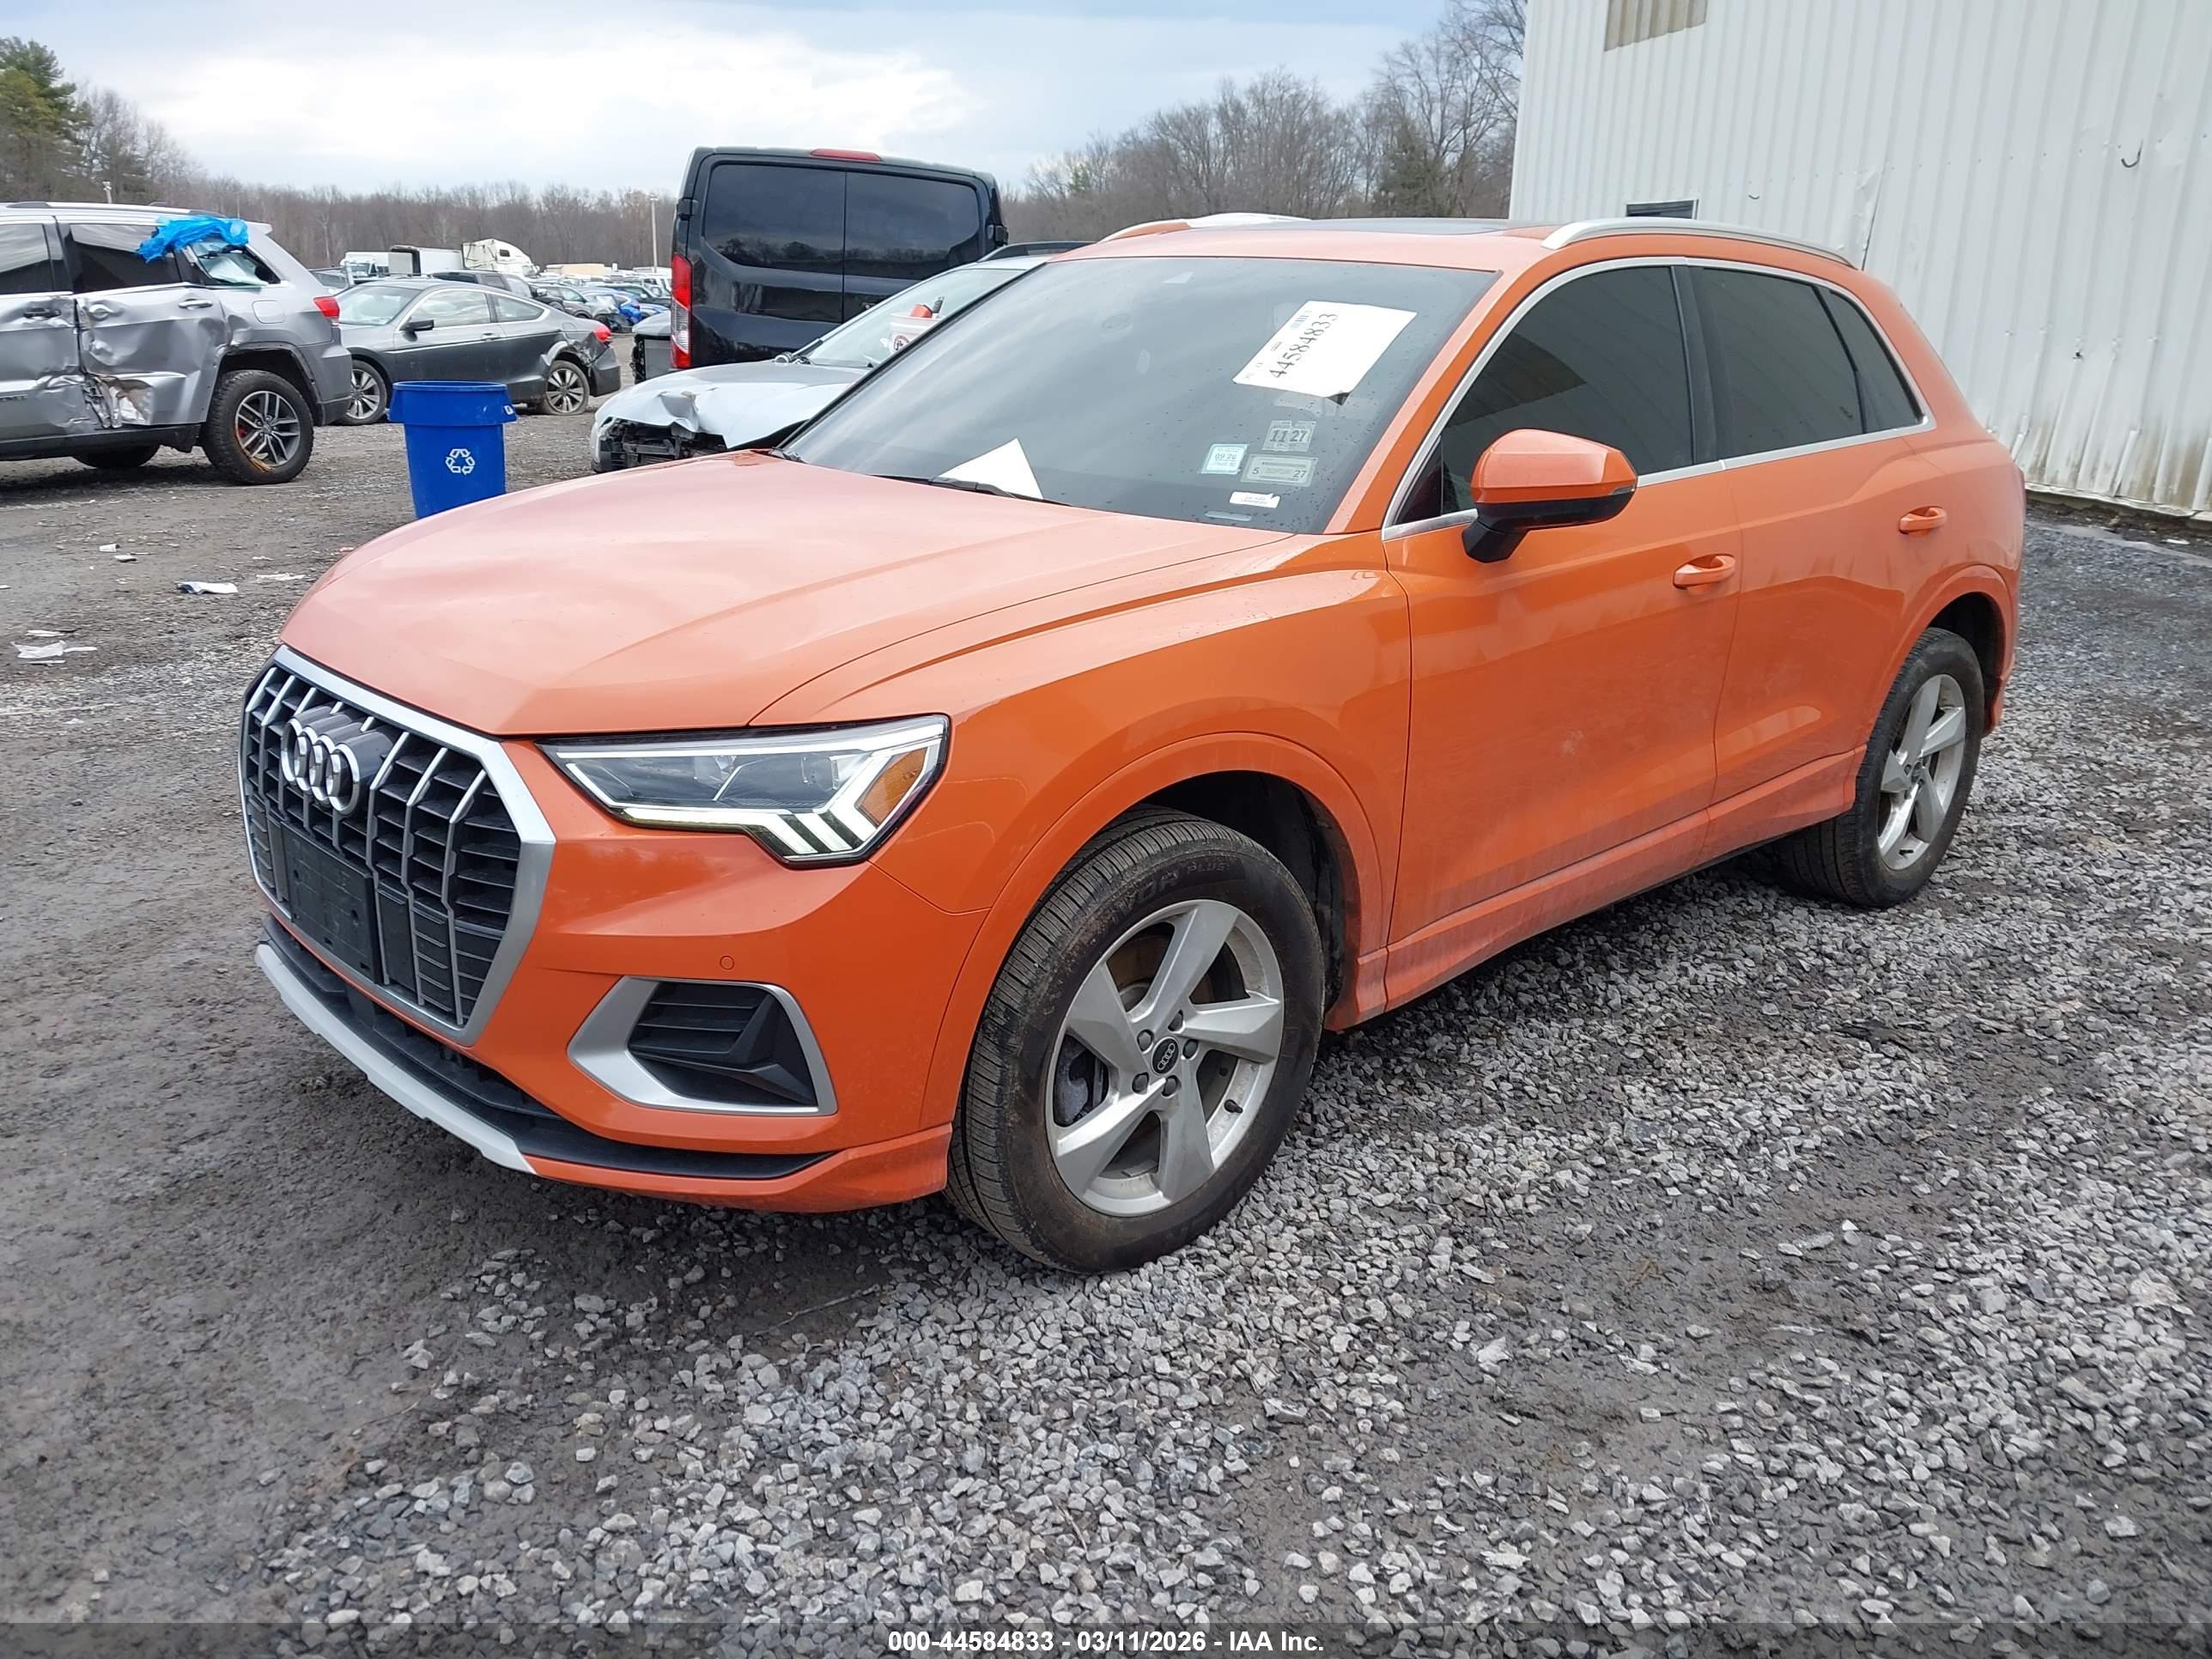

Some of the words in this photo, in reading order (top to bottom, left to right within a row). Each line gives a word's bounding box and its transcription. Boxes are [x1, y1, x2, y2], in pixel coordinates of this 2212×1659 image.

[1268, 313, 1340, 379] 44584833
[1269, 429, 1288, 443] 11
[1289, 429, 1308, 442] 27
[1291, 469, 1307, 478] 27
